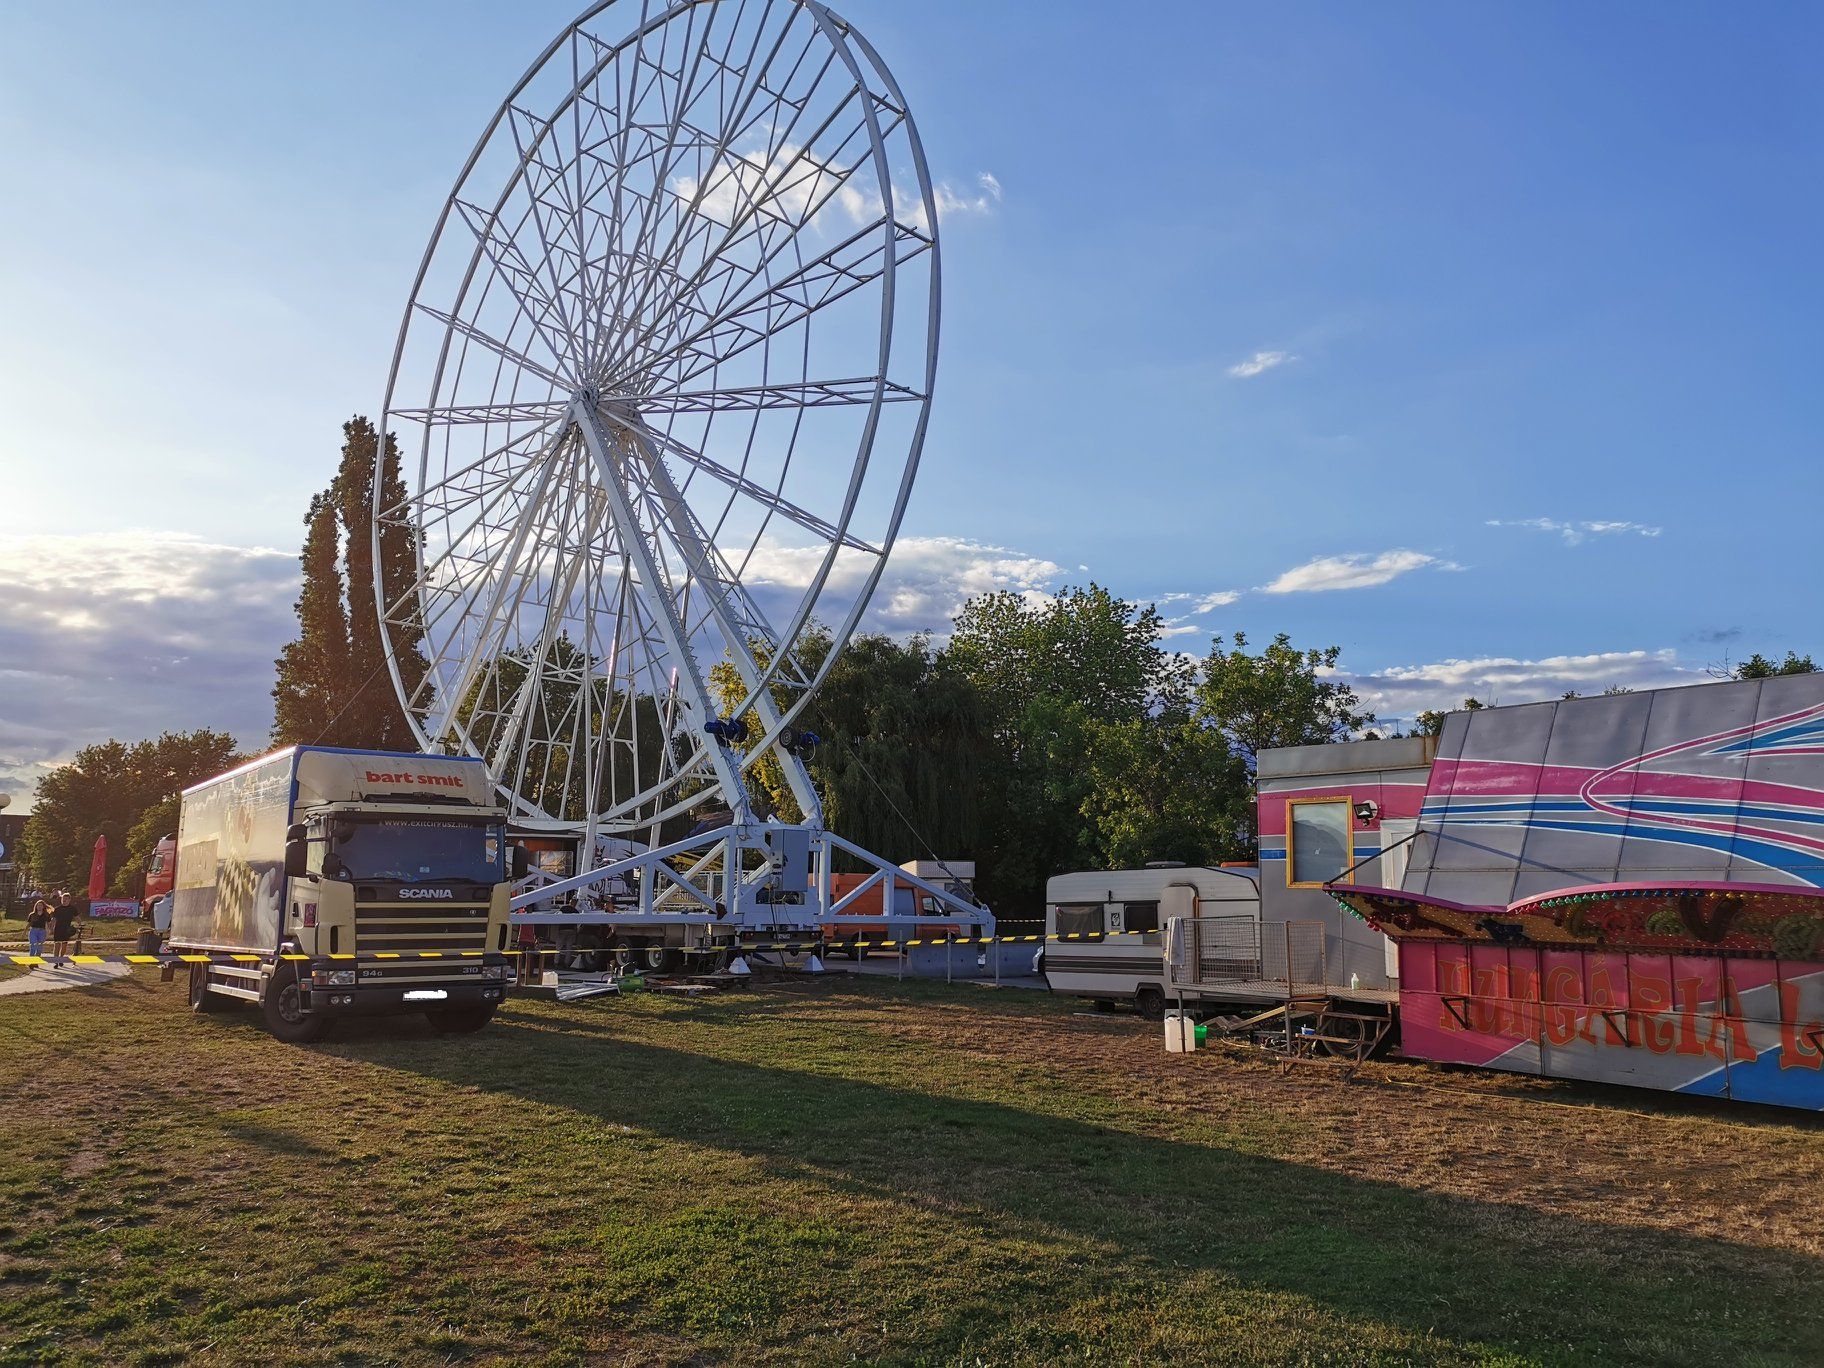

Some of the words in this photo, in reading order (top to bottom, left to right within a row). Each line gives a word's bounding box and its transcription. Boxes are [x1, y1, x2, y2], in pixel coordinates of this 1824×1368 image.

[365, 771, 414, 784] bart
[417, 775, 464, 788] smit
[399, 888, 453, 899] SCANIA
[462, 966, 479, 974] 310
